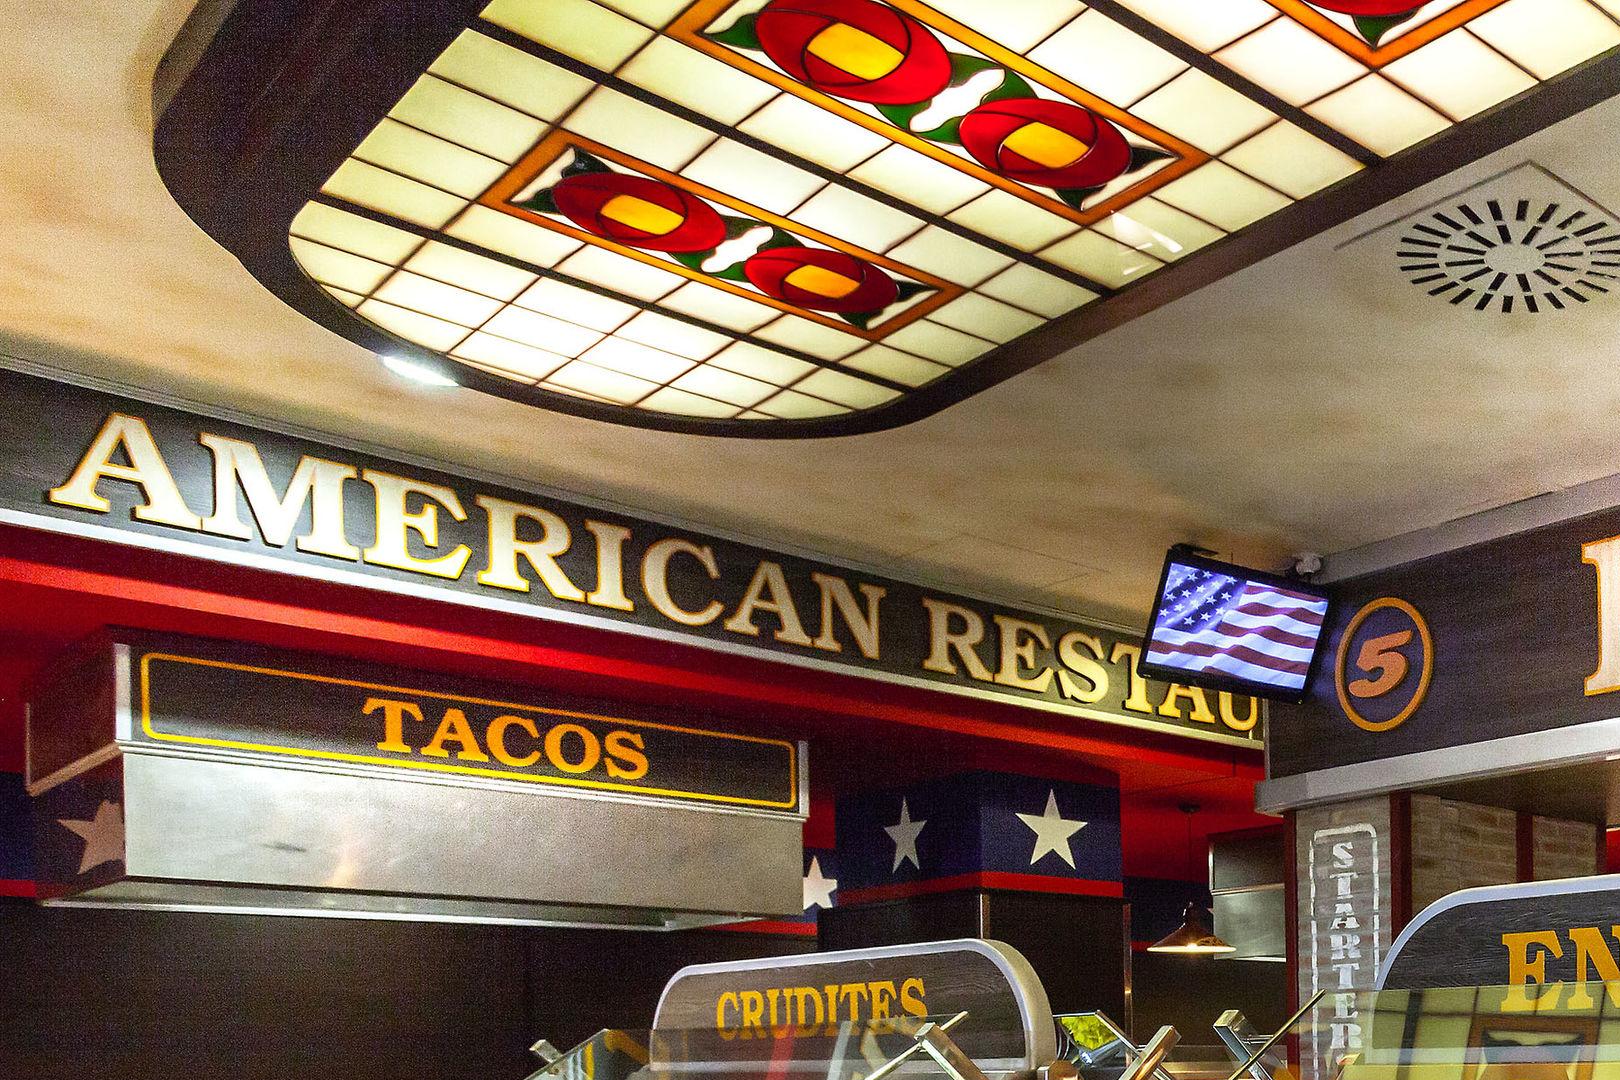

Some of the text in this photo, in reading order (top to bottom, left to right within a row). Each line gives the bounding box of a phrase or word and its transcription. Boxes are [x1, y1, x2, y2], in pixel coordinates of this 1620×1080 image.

[48, 411, 887, 660] AMERICAN
[1348, 630, 1412, 699] 5
[362, 697, 649, 781] TACOS
[1328, 840, 1362, 1066] STARTER
[716, 977, 928, 1042] CRUDITES
